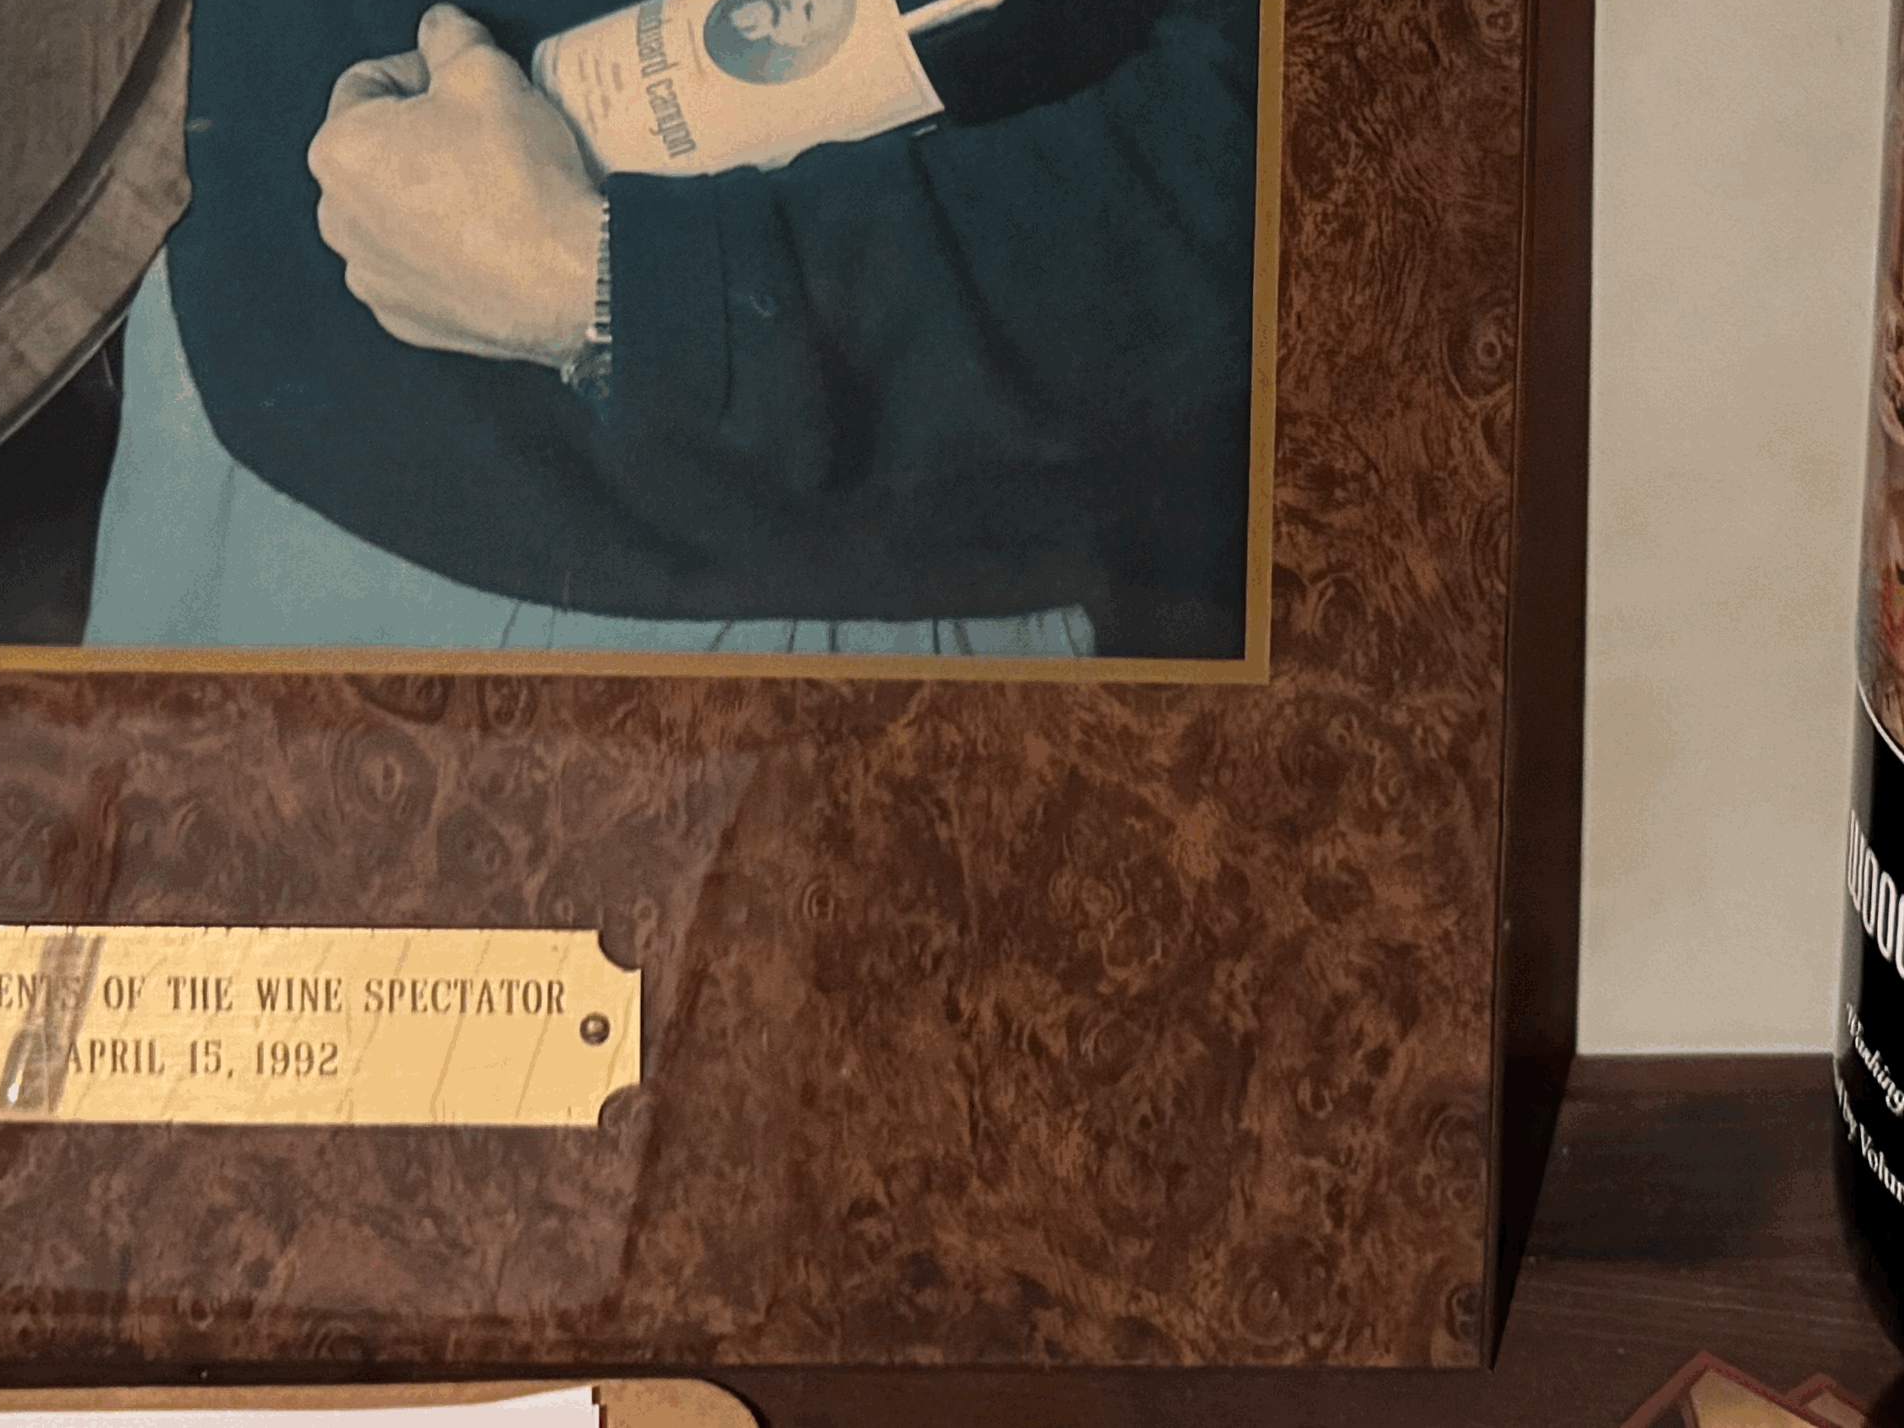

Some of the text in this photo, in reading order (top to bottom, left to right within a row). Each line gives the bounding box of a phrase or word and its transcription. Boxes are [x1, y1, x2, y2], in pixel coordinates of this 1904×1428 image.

[103, 975, 146, 1010] OF
[167, 976, 233, 1012] THE
[257, 977, 343, 1014] WINE
[364, 978, 566, 1016] SPECTATOR
[66, 1039, 338, 1080] APRIL 15, 1992
